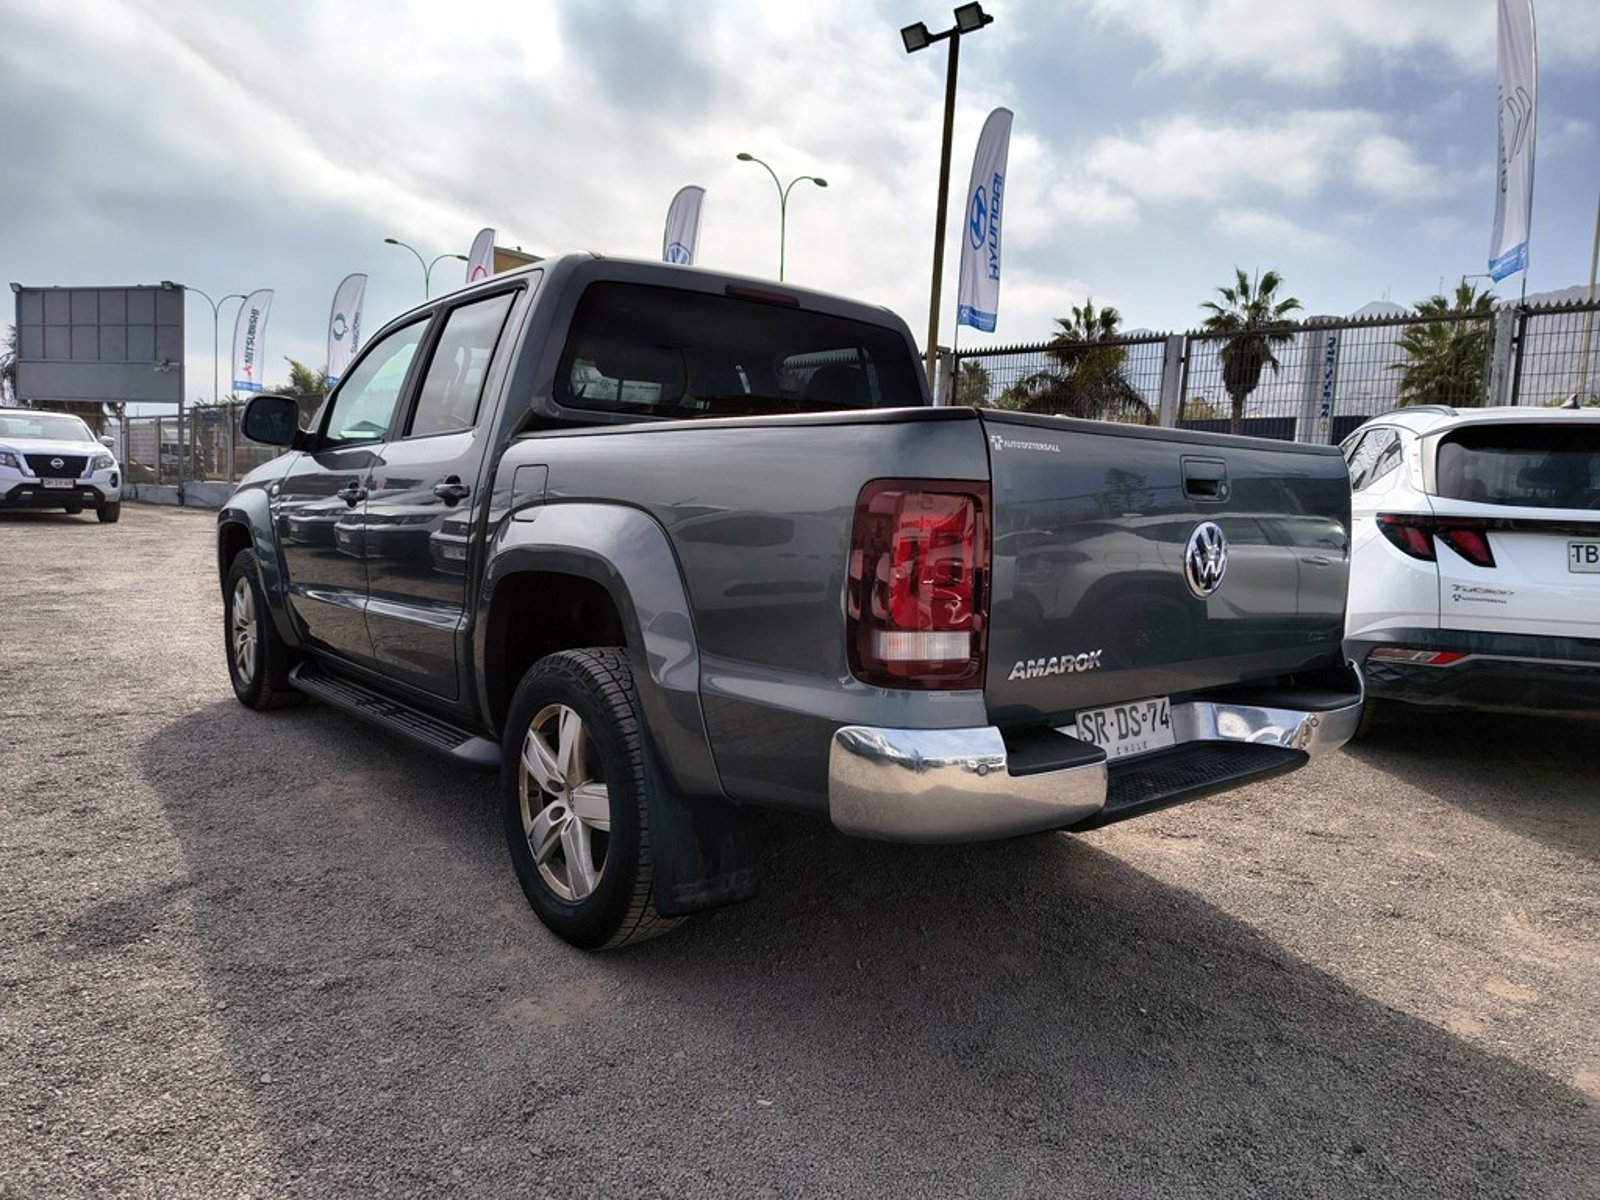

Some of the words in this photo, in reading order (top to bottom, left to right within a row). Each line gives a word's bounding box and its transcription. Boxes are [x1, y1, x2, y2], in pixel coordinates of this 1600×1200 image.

[989, 172, 1004, 281] HYUNDAI
[245, 308, 260, 363] MITSUBISHI
[1007, 649, 1103, 681] AMAROK
